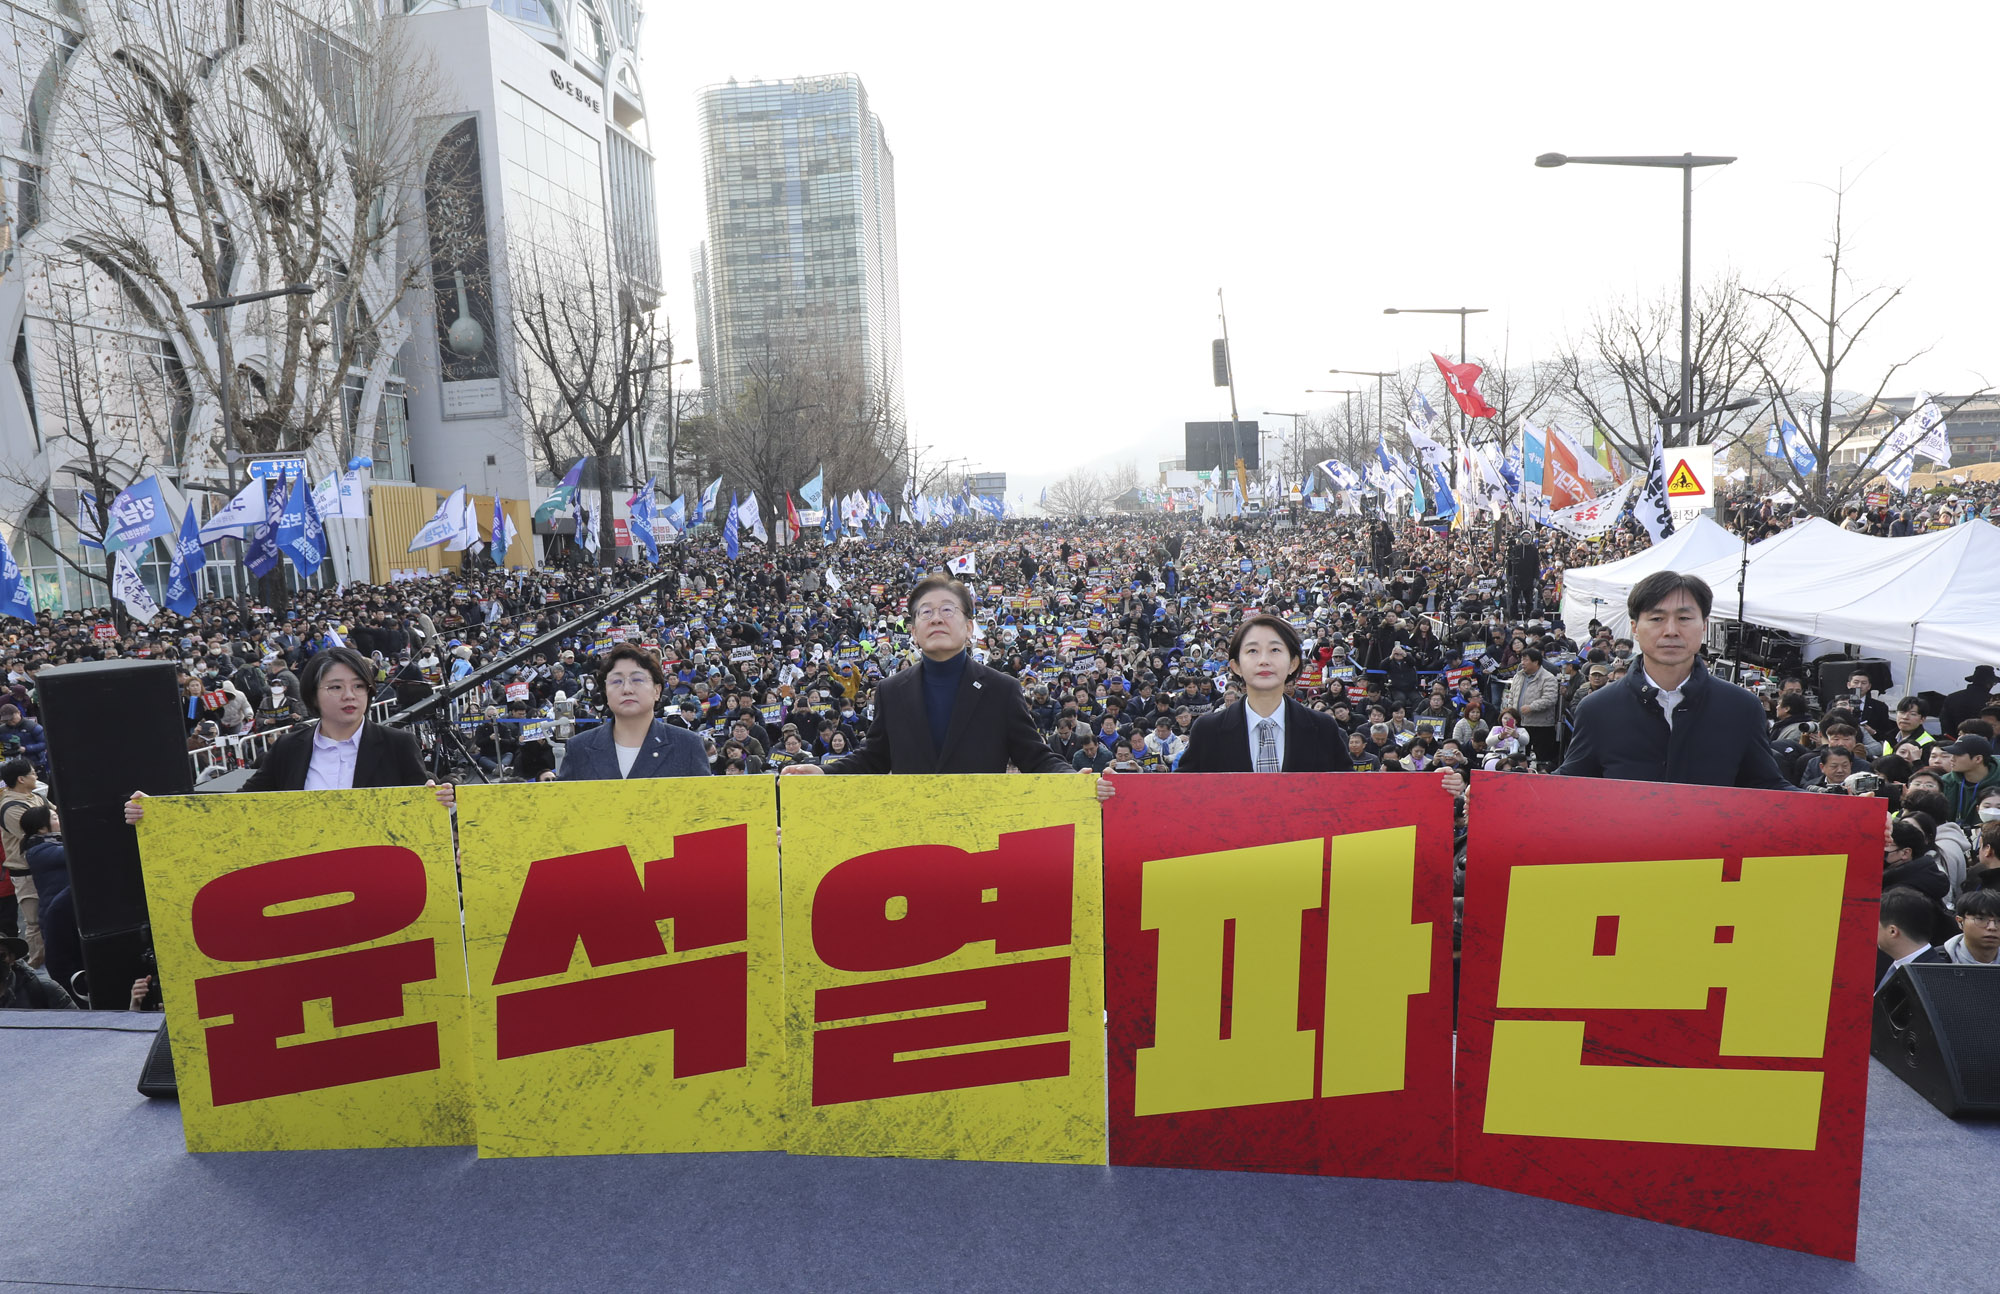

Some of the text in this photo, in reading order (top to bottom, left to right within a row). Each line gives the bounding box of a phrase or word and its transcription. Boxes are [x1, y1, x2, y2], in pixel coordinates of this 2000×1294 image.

[455, 133, 471, 147] ONE
[192, 823, 1847, 1151] 윤석열 파면
